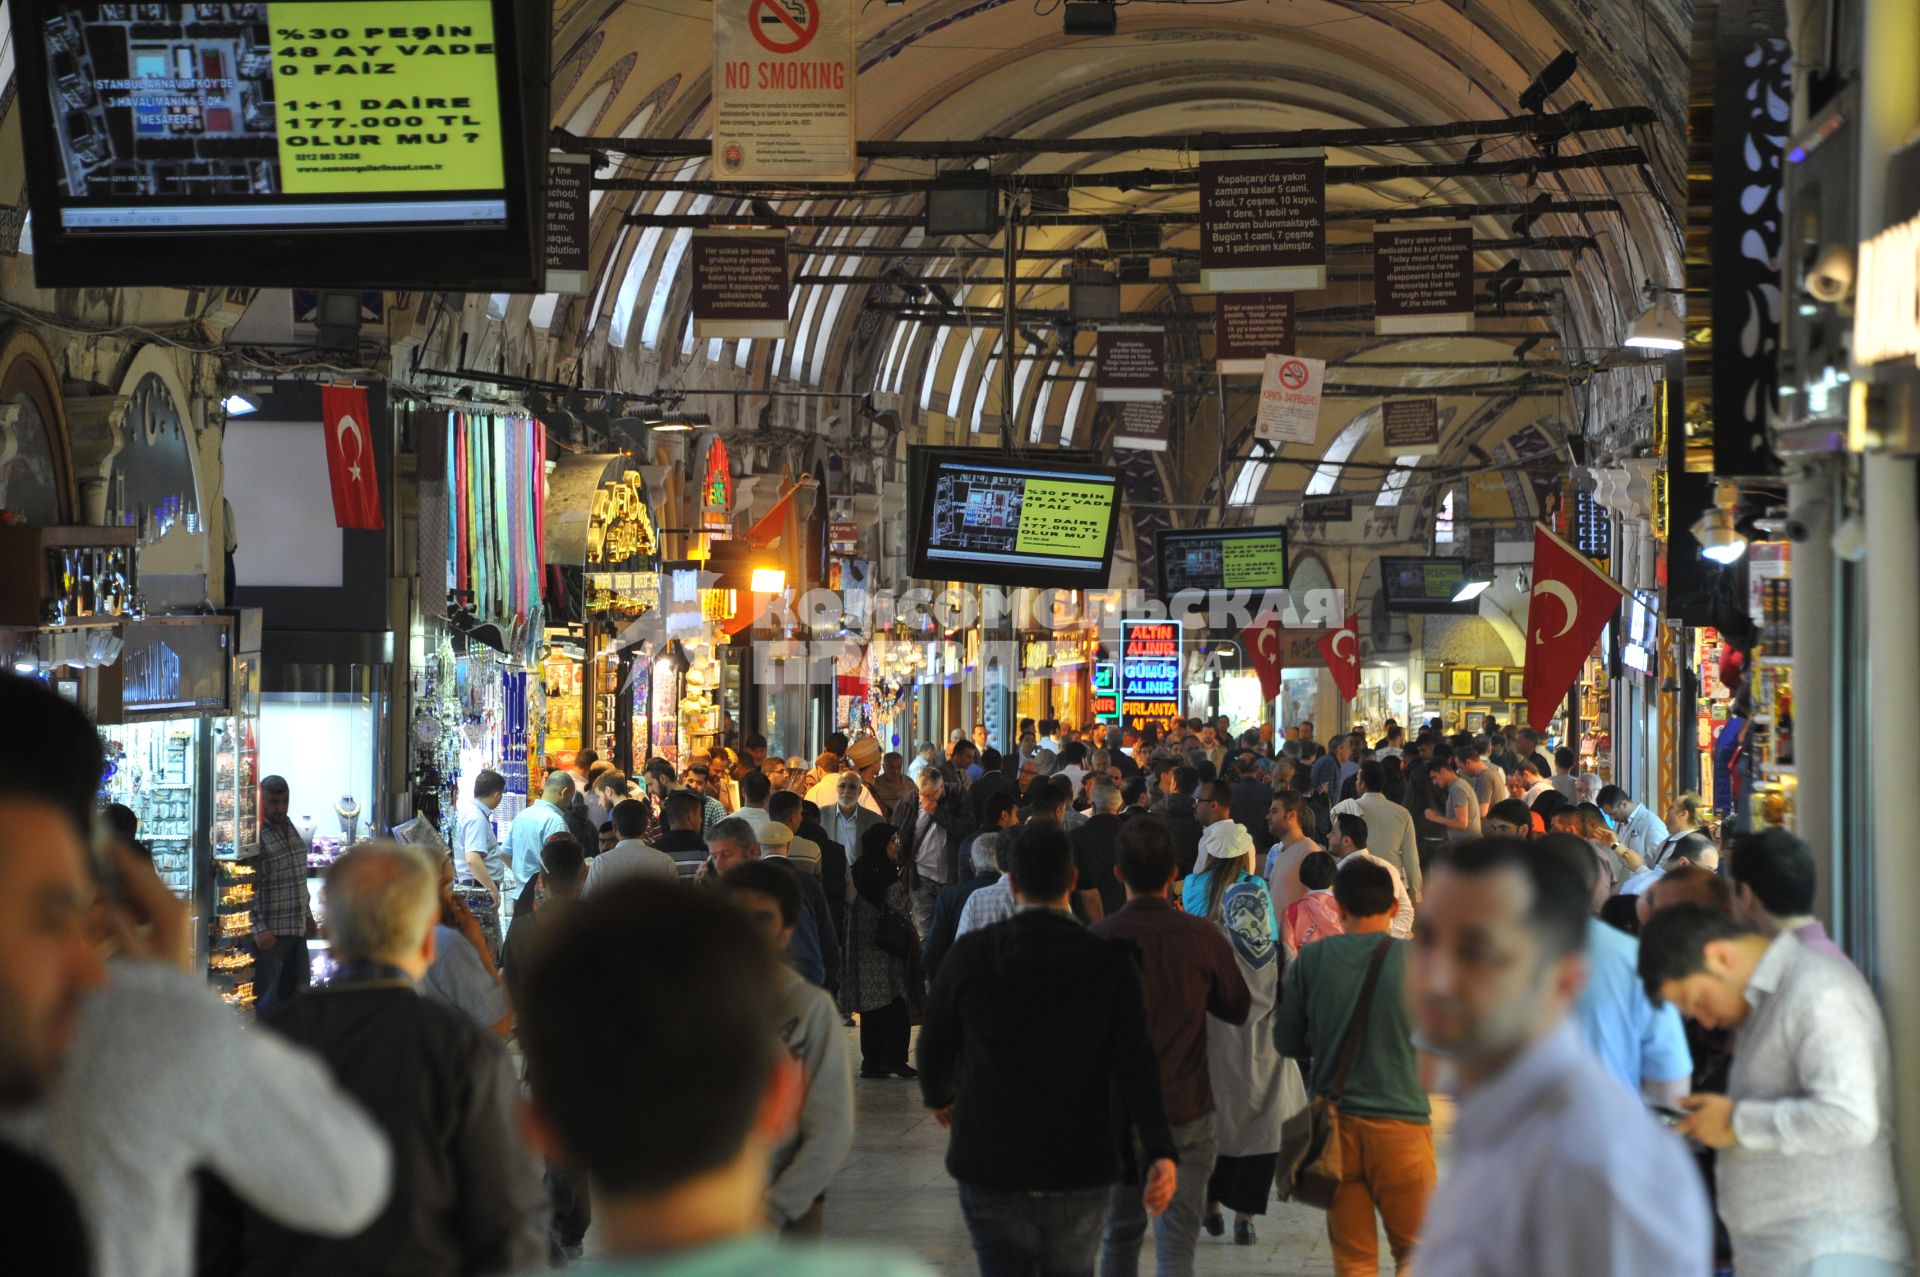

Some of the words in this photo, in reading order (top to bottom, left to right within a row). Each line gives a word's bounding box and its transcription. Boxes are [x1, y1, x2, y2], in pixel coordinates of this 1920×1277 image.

[277, 28, 349, 40] %30
[364, 24, 472, 40] PEŞİN
[277, 47, 319, 57] 48
[333, 46, 382, 57] AY
[396, 44, 496, 56] VADE
[279, 64, 298, 76] 0
[314, 62, 395, 75] FAİZ
[725, 62, 750, 90] NO
[758, 62, 844, 90] SMOKING
[207, 96, 222, 106] DK
[283, 100, 342, 111] 1+1
[360, 96, 470, 110] DAİRE
[140, 114, 194, 125] MESAFEDE
[285, 116, 424, 128] 177.000
[437, 115, 480, 126] TL
[285, 134, 381, 146] OLUR
[396, 134, 448, 144] MU
[463, 132, 479, 144] ?
[557, 166, 572, 174] the
[556, 177, 580, 186] home
[1218, 174, 1280, 186] Kapalıçarşı'da
[1282, 172, 1306, 183] yakın
[1215, 187, 1249, 196] zamana
[1251, 186, 1276, 194] kadar
[1278, 185, 1283, 193] 5
[1285, 184, 1310, 194] cami,
[1215, 198, 1238, 208] okul,
[1240, 198, 1244, 206] 7
[1246, 198, 1278, 208] çeşme,
[1280, 196, 1290, 205] 10
[1292, 196, 1318, 206] kuyu,
[558, 212, 575, 220] and
[1226, 210, 1230, 218] 1
[1234, 210, 1256, 219] dere,
[1258, 208, 1262, 216] 1
[1266, 208, 1286, 216] sebil
[1288, 208, 1300, 216] ve
[1206, 222, 1210, 230] 1
[1213, 220, 1250, 231] şadırvan
[1252, 218, 1320, 229] bulunmaktaydı.
[1212, 232, 1242, 244] Bugün
[1244, 232, 1248, 240] 1
[1251, 231, 1276, 240] cami,
[1276, 230, 1282, 238] 7
[1284, 230, 1314, 240] çeşme
[1394, 237, 1414, 246] Every
[1226, 244, 1230, 252] 1
[1233, 243, 1270, 254] şadırvan
[1273, 241, 1314, 252] kalmıştır.
[1378, 246, 1412, 254] dedicated
[1429, 244, 1468, 253] profession.
[1388, 256, 1410, 264] Today
[1394, 264, 1435, 273] professions
[1387, 274, 1430, 282] disappeared
[1394, 282, 1428, 290] memories
[1392, 291, 1419, 300] through
[1420, 290, 1432, 298] the
[1400, 300, 1408, 308] of
[1061, 491, 1105, 500] PEŞİN
[1038, 502, 1072, 512] FAİZ
[1073, 499, 1112, 508] VADE
[1024, 516, 1047, 524] 1+1
[1054, 517, 1098, 526] DAİRE
[1022, 522, 1077, 532] 177.000
[1084, 526, 1100, 534] TL
[1021, 529, 1059, 538] OLUR
[1064, 532, 1086, 540] MU
[1130, 625, 1173, 639] ALTIN
[1127, 642, 1176, 655] ALINIR
[1124, 662, 1178, 682] GÜMÜŞ
[1127, 681, 1175, 694] ALINIR
[1122, 702, 1178, 716] PIRLANTA
